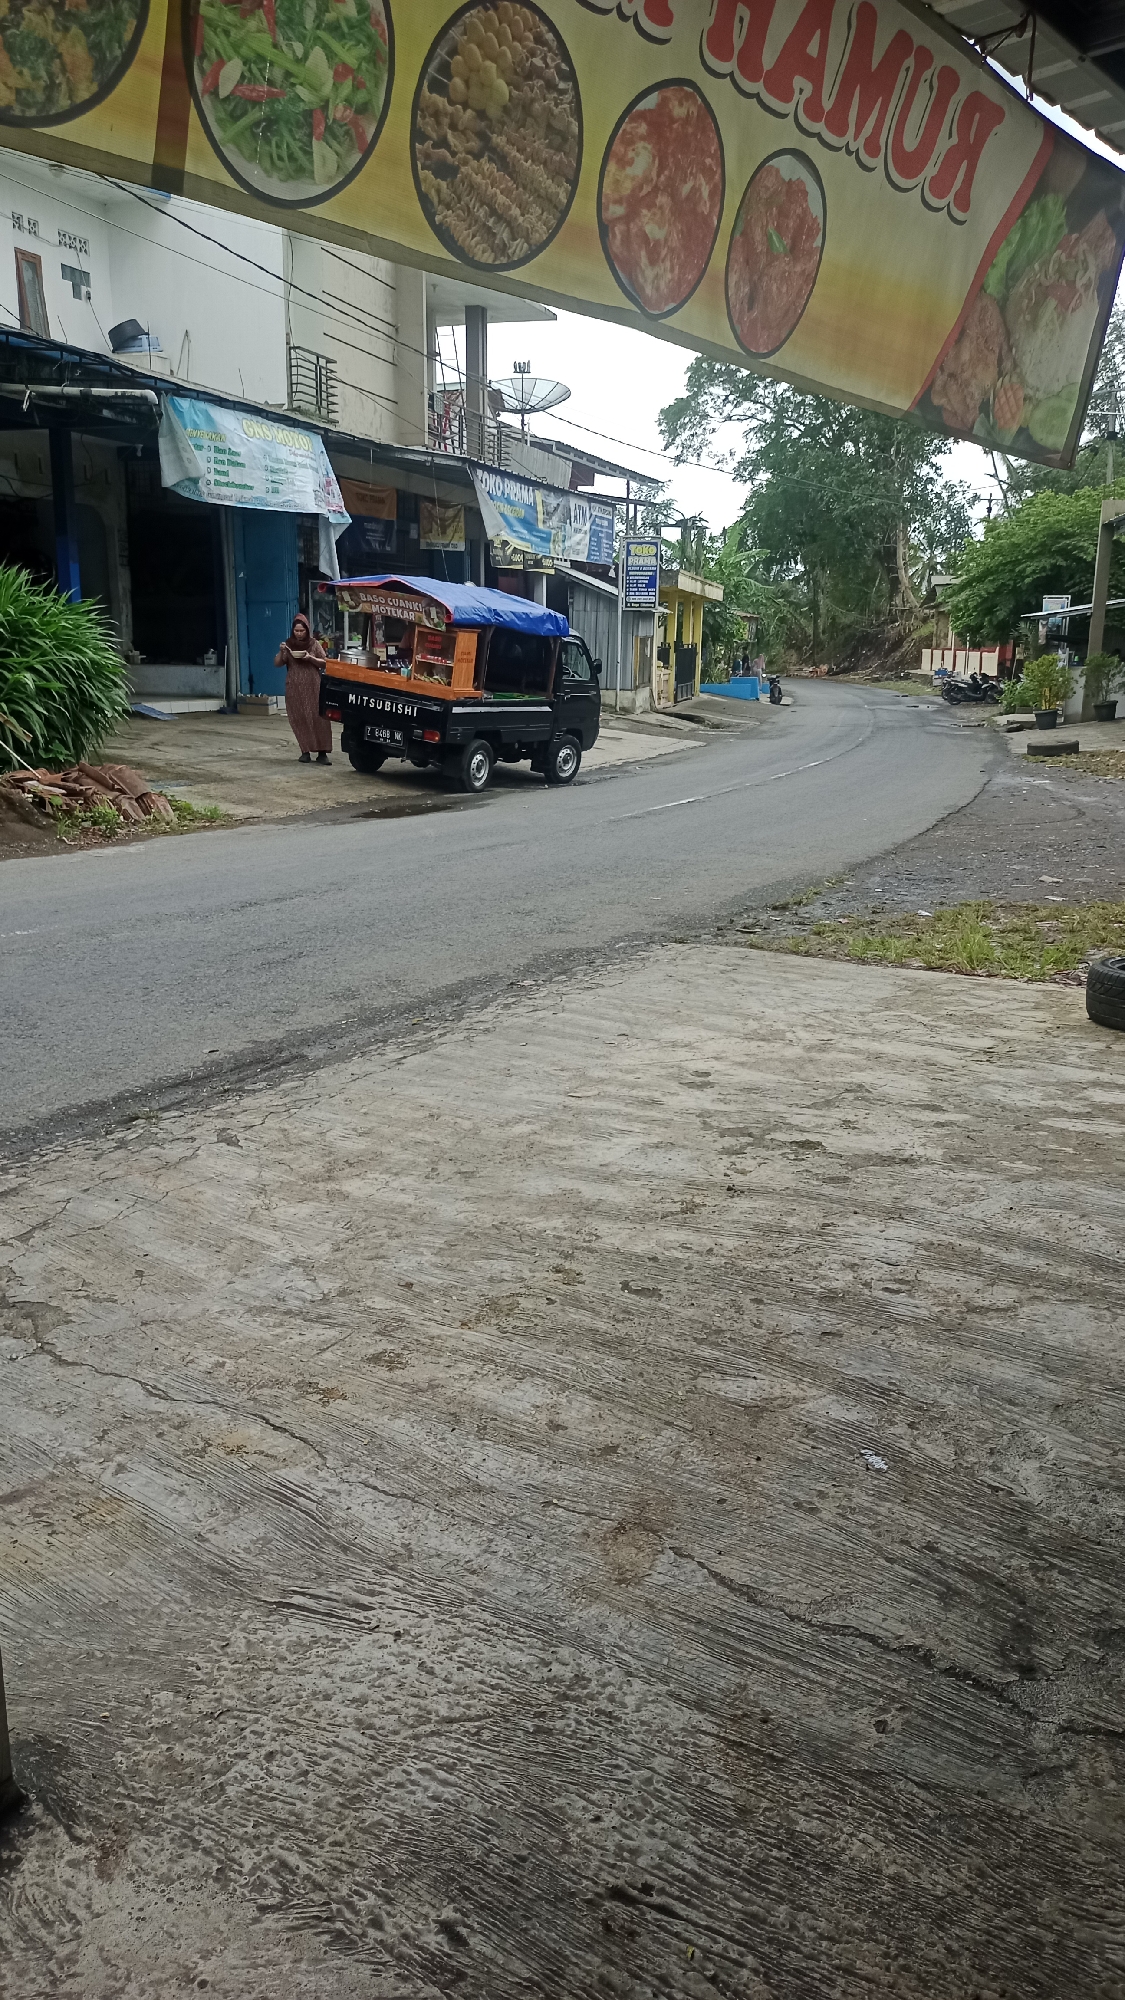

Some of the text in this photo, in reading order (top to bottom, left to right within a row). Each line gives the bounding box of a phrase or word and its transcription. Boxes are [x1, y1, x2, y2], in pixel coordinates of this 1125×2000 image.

[242, 418, 273, 441] GNS
[476, 469, 534, 507] TOKO PRAMA
[627, 556, 657, 566] PRAMA
[629, 544, 657, 557] TOKO
[359, 592, 423, 613] BASO CUANKI
[371, 604, 416, 621] MOTEKAR
[348, 693, 418, 717] MITSUBISHI
